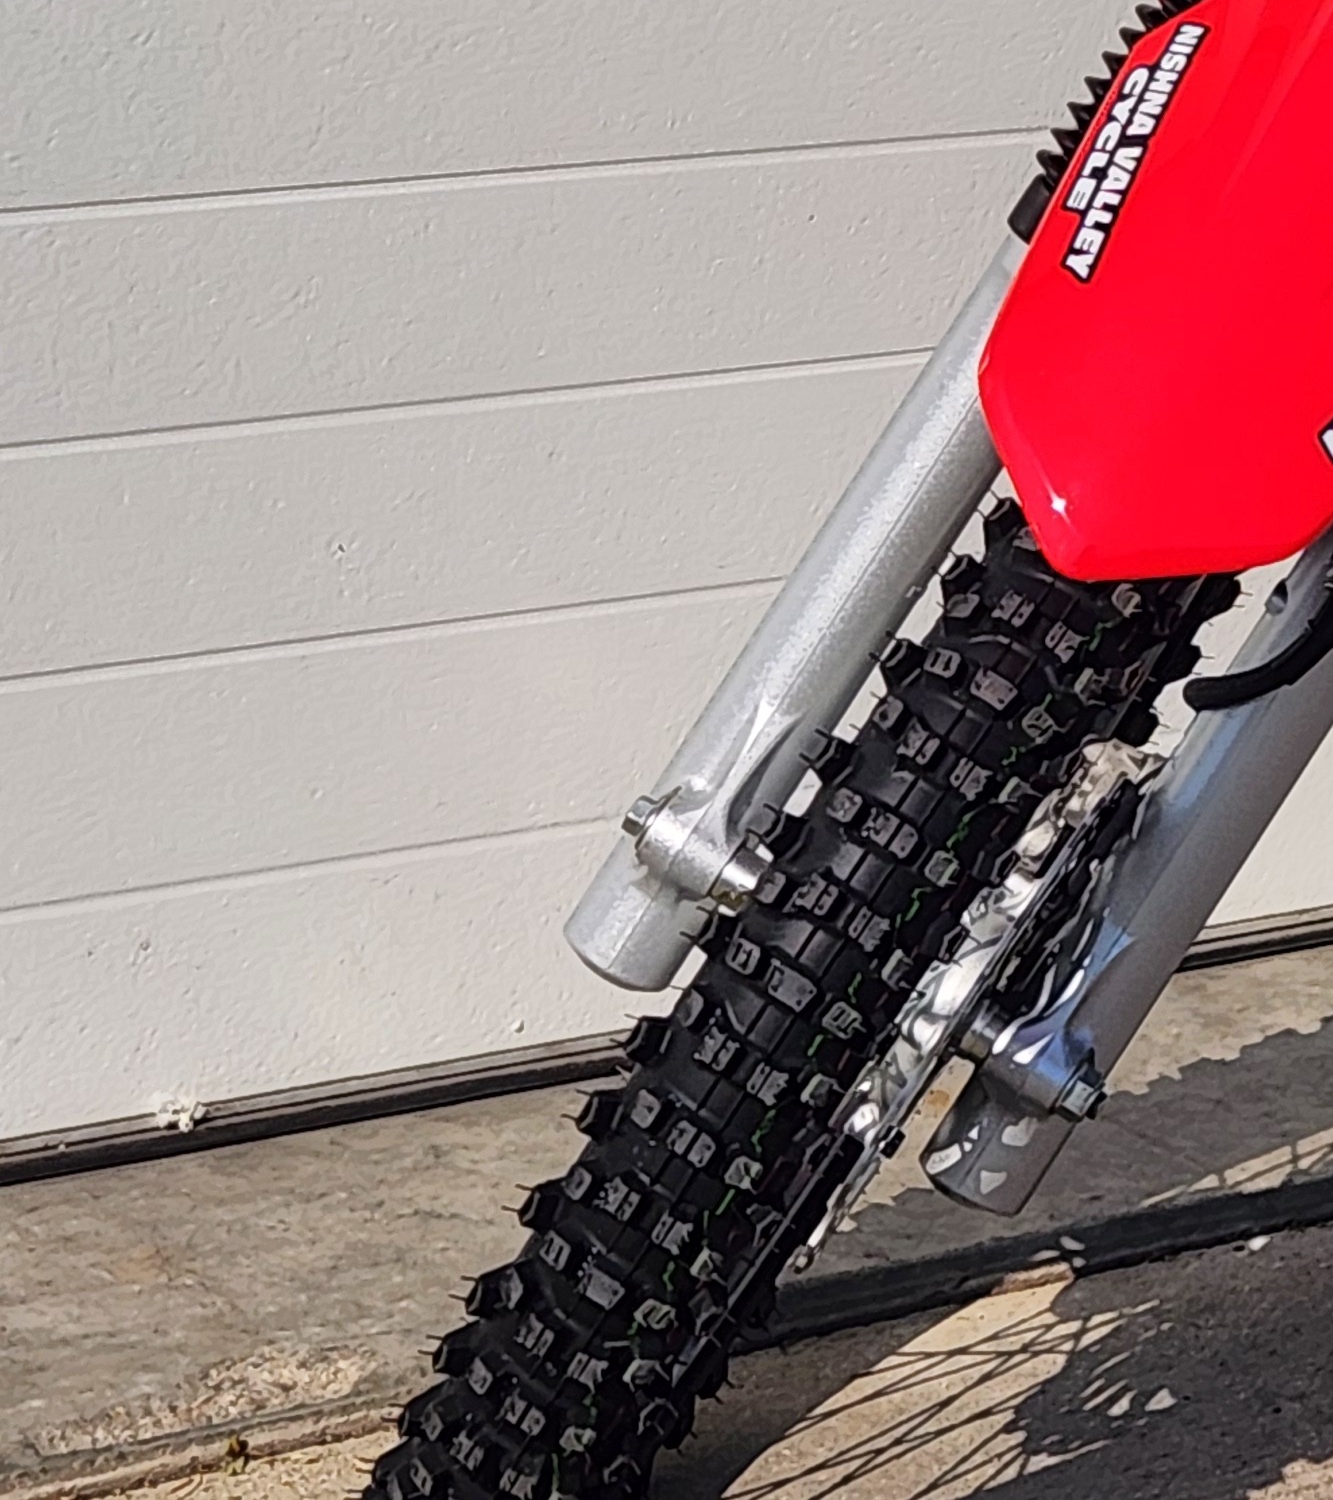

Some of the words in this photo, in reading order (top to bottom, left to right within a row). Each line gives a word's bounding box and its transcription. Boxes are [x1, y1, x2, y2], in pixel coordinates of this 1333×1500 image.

[1065, 66, 1151, 211] CYCLE
[1125, 23, 1206, 137] NISHNA
[1064, 145, 1145, 280] VALLEY
